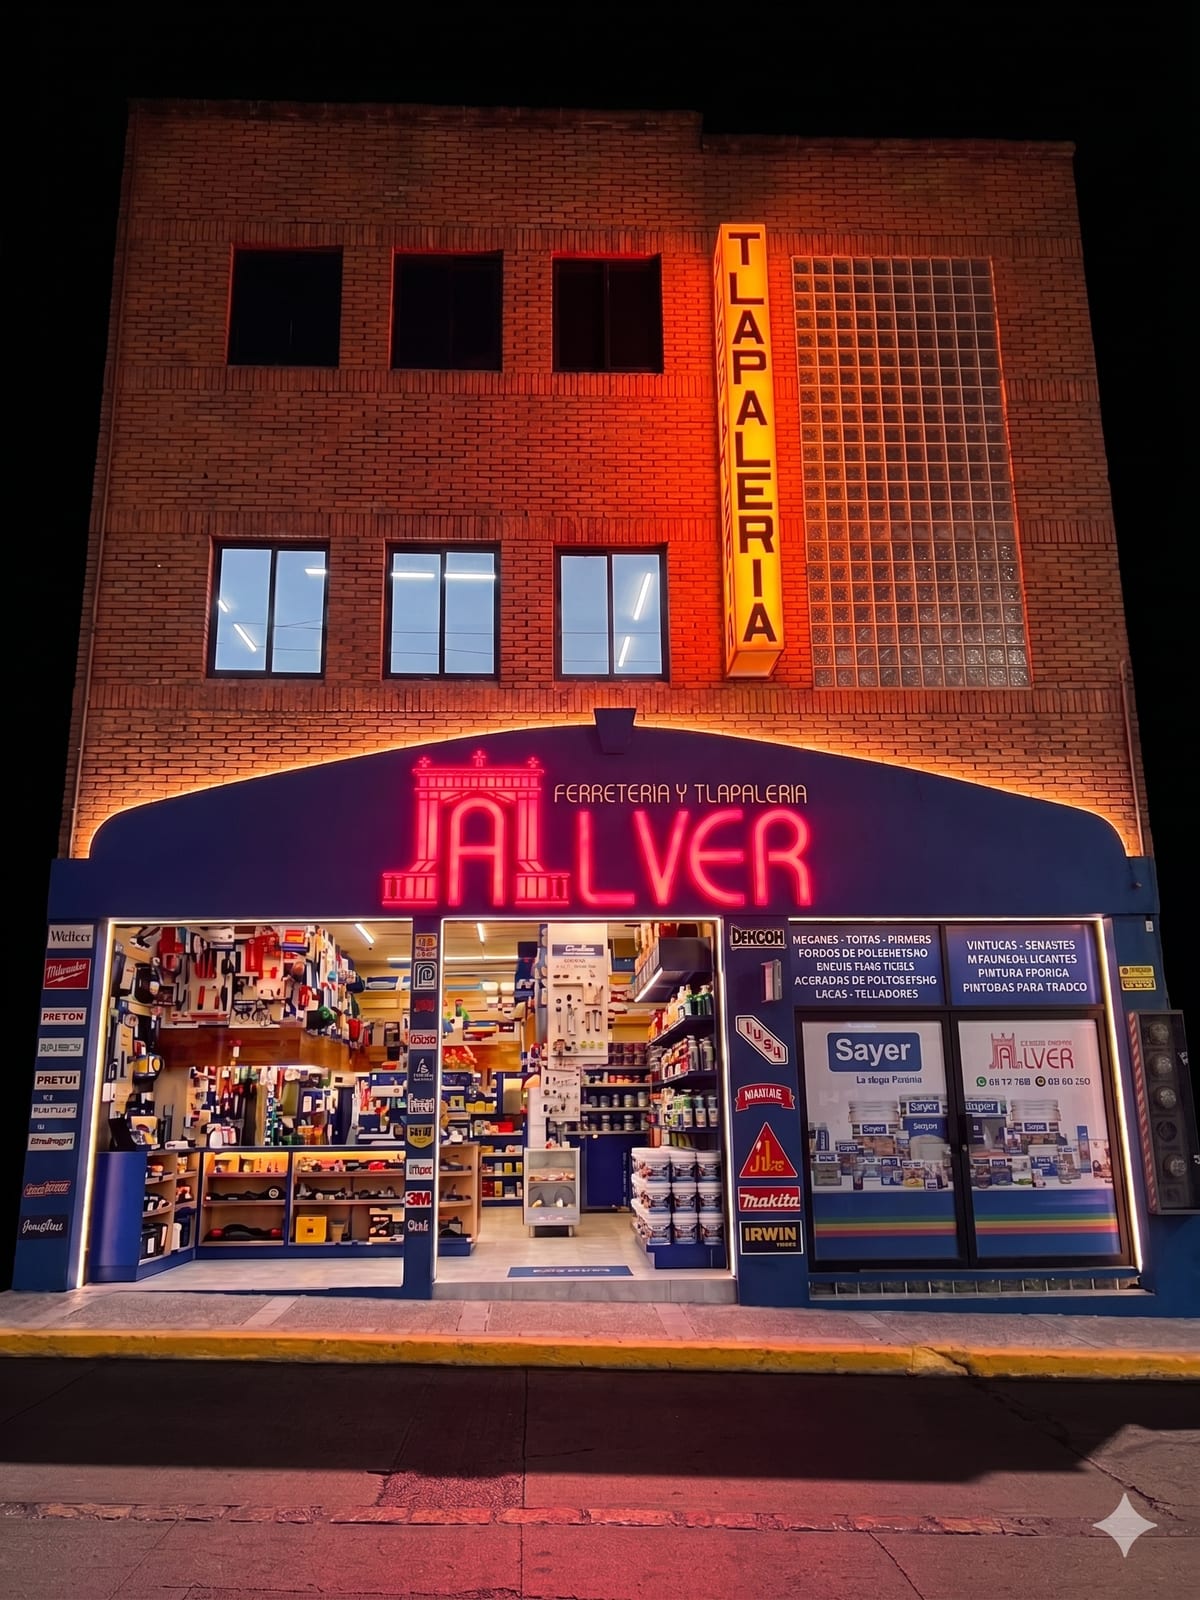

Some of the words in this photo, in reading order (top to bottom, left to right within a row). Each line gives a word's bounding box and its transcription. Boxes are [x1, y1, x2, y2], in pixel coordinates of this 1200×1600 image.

[728, 232, 777, 642] TLAPALERIA
[554, 783, 670, 803] FERRETERIA
[676, 784, 688, 803] Y
[694, 784, 808, 804] TLAPALERIA
[798, 948, 841, 958] FORDOS
[842, 948, 856, 958] DE
[852, 976, 866, 985] DE
[1017, 983, 1044, 992] PARA
[43, 1013, 84, 1021] PRETON
[835, 1038, 911, 1067] Sayer
[407, 1192, 431, 1206] 3M
[745, 1227, 797, 1241] IRWIN
